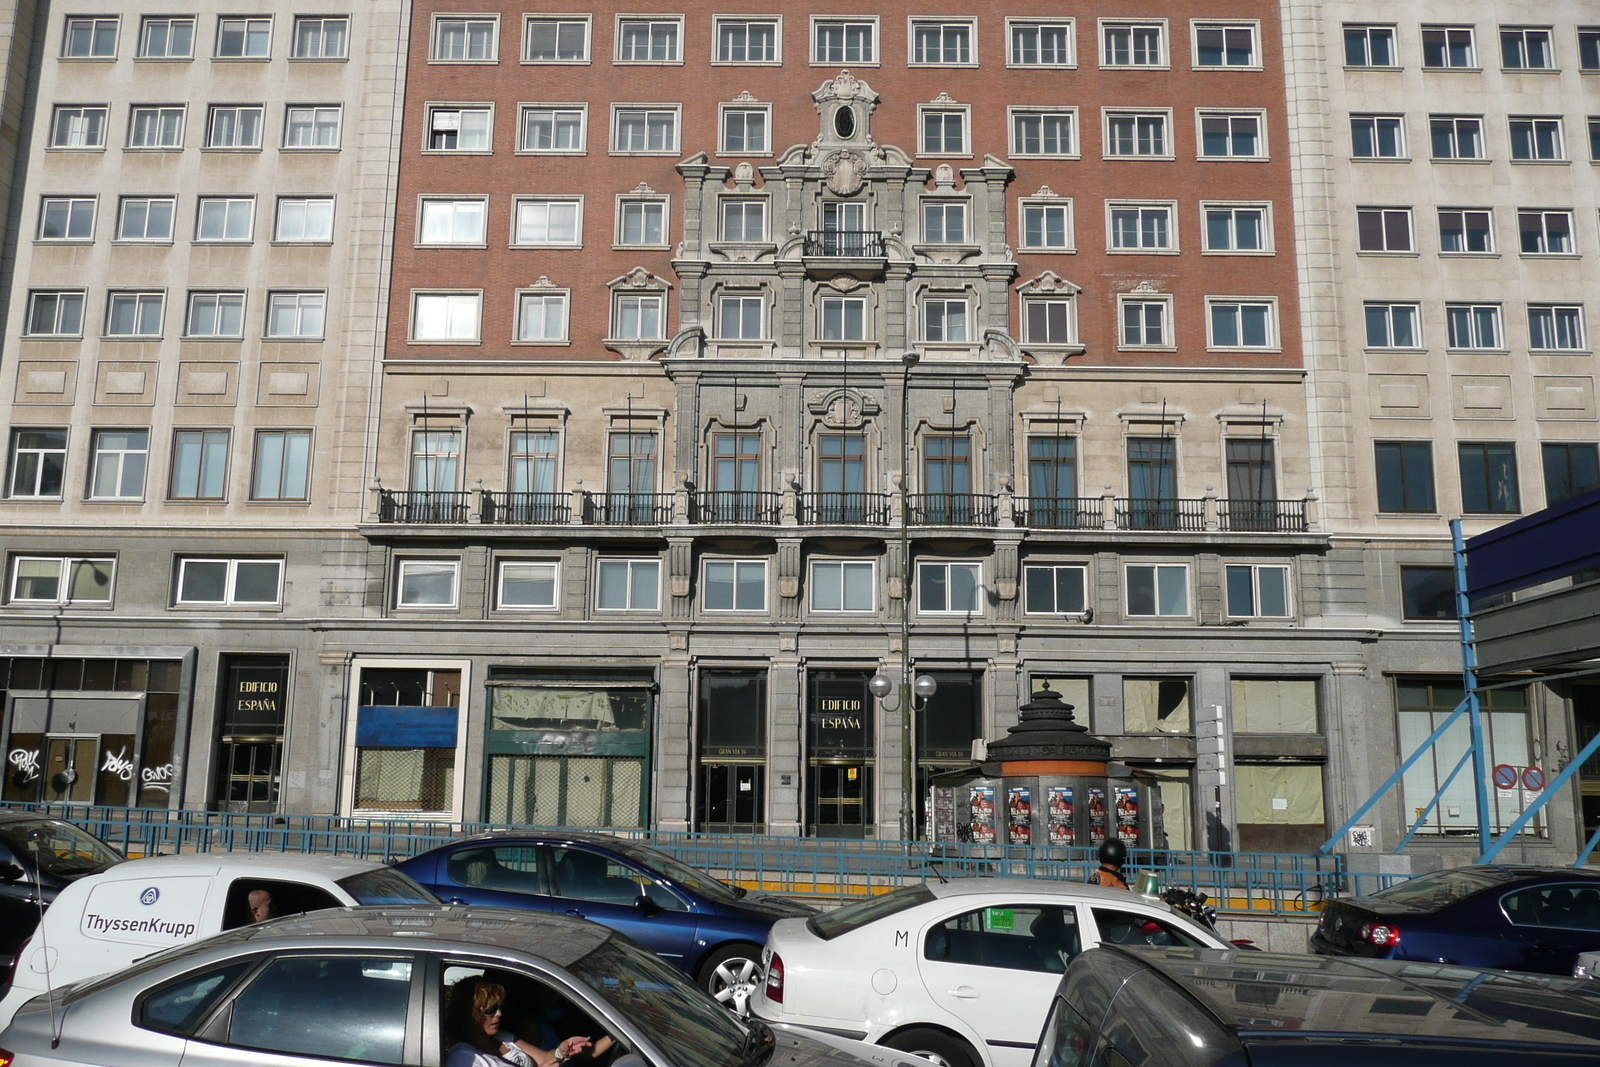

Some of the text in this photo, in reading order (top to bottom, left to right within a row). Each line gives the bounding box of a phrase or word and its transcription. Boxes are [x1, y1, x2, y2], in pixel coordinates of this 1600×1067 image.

[239, 681, 278, 693] EDIFICIO
[238, 698, 276, 711] ESPAÑA
[822, 699, 861, 711] EDIFICIO
[822, 716, 861, 729] ESPAÑA
[86, 913, 195, 939] ThyssenKrupp
[895, 929, 909, 948] M
